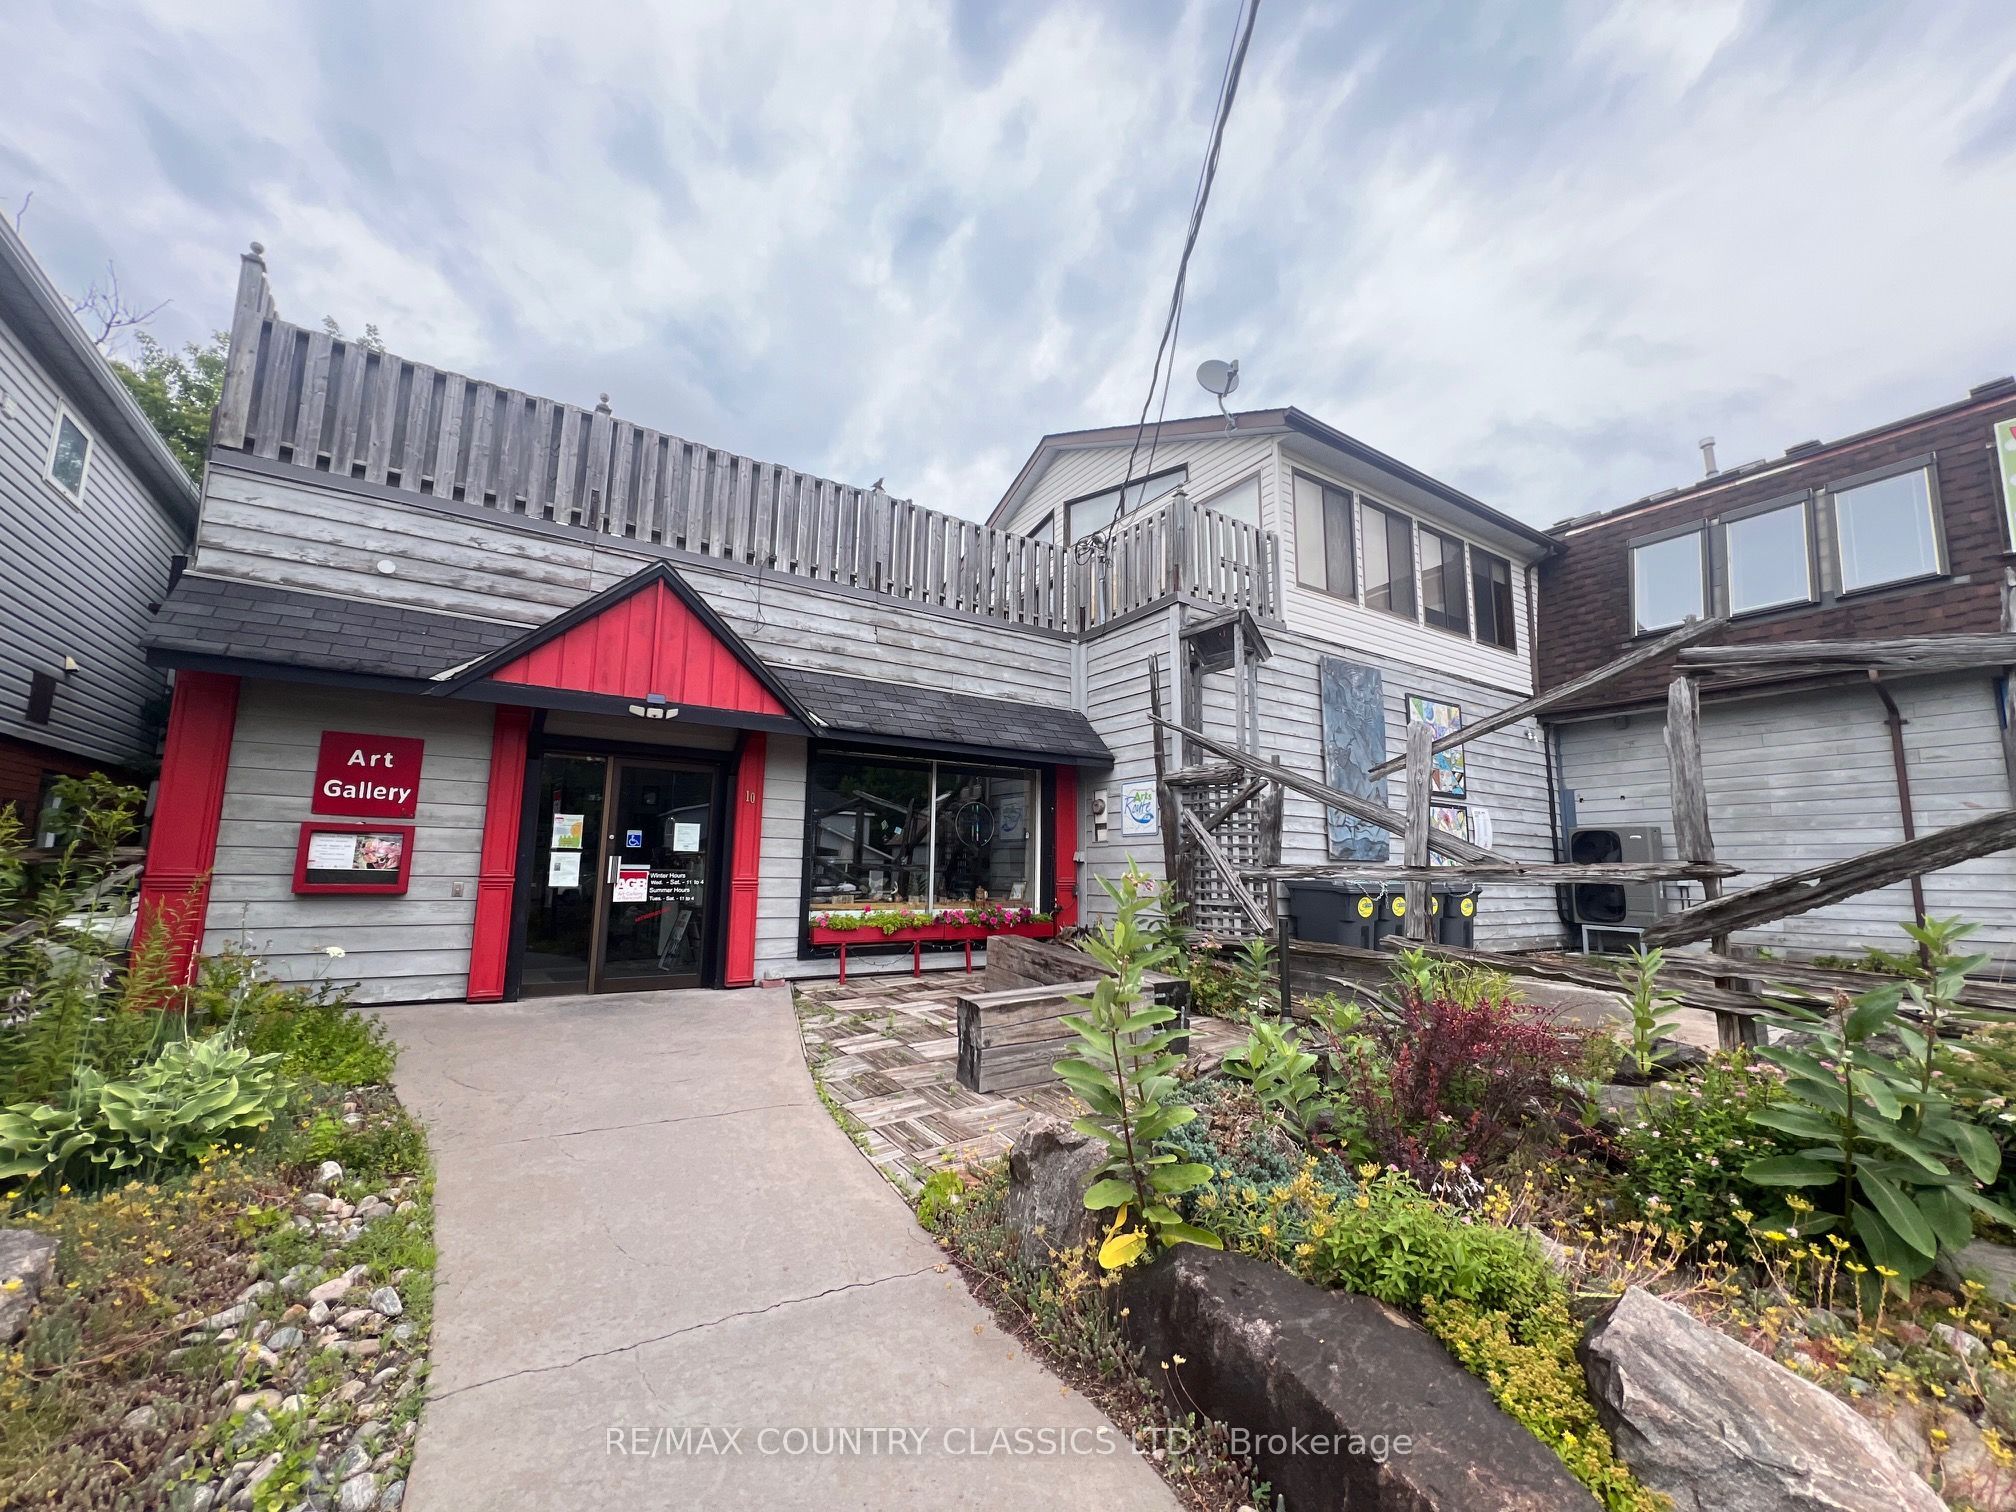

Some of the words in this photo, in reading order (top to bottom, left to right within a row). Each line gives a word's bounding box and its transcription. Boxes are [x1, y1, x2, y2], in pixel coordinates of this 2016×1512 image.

[347, 749, 394, 768] Art
[323, 779, 412, 804] Gallery
[745, 790, 756, 804] 10
[1135, 792, 1151, 802] Arts
[615, 878, 647, 889] AGB
